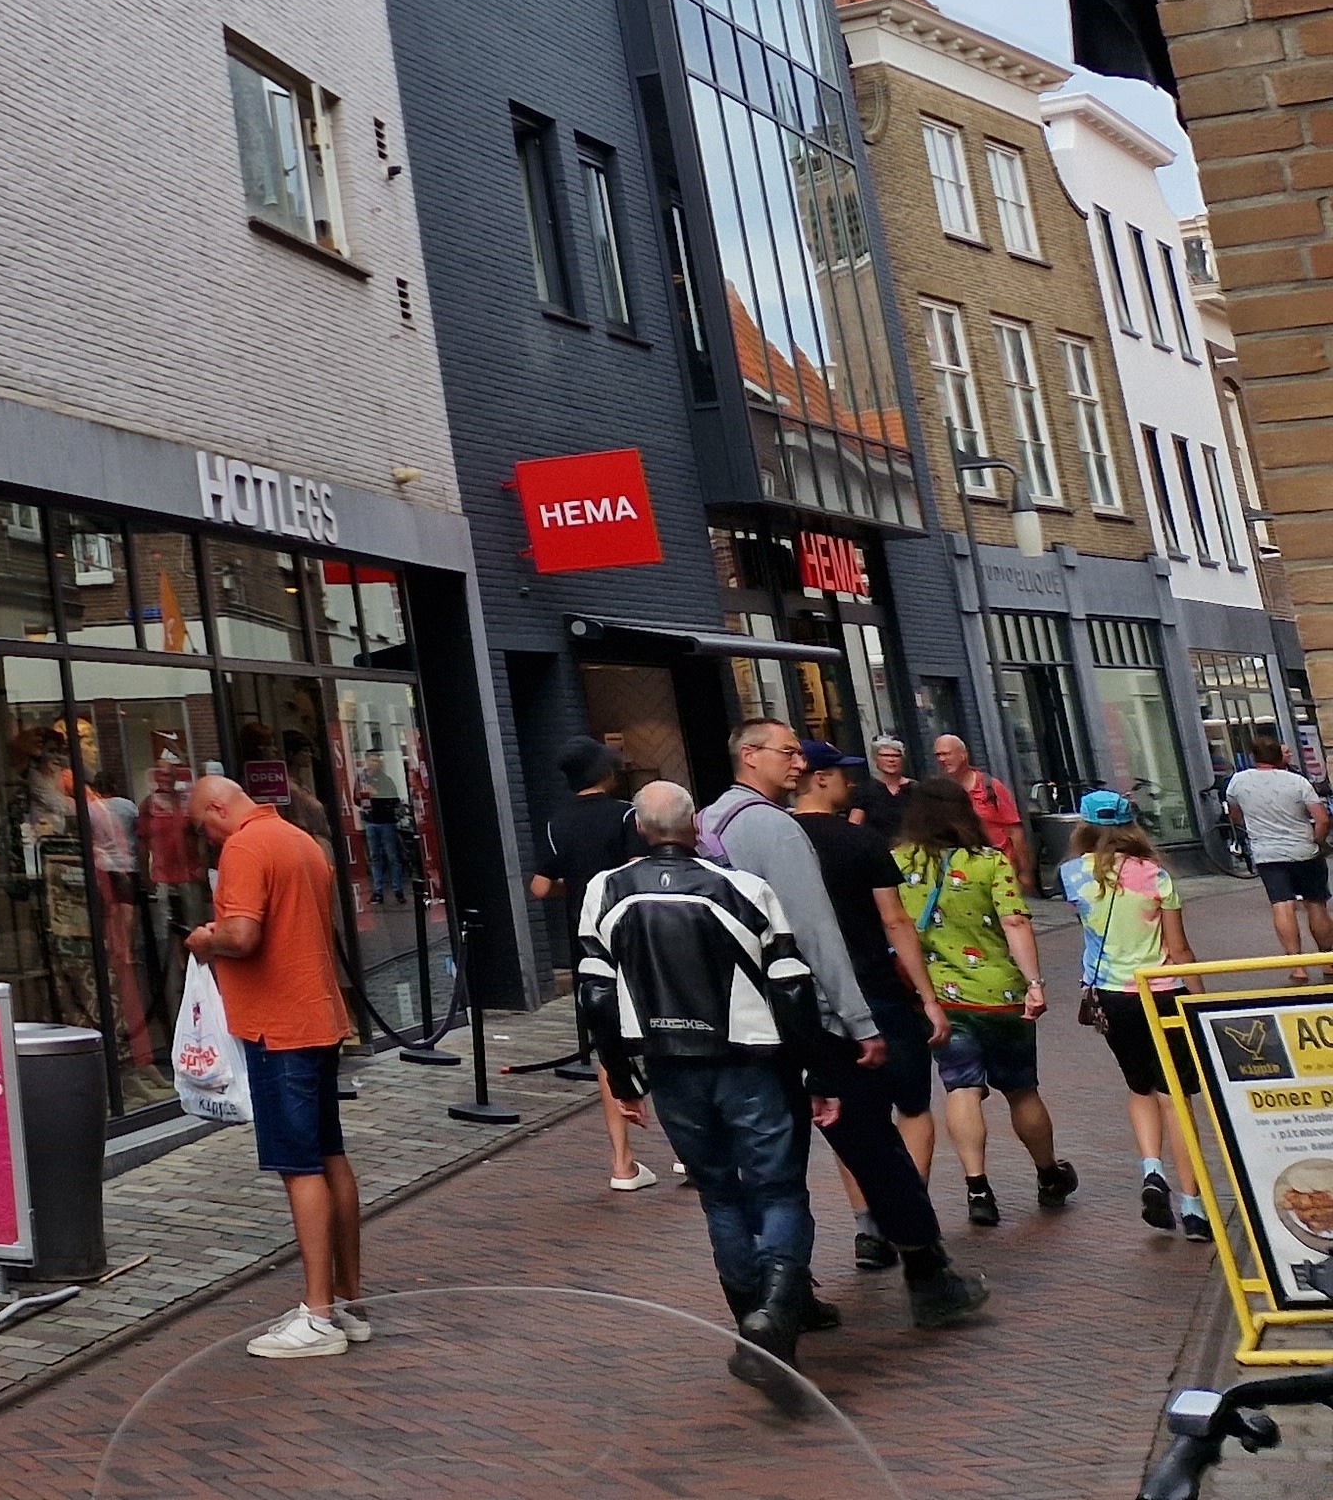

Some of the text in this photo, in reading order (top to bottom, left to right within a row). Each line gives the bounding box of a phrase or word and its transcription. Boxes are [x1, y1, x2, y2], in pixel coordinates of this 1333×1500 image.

[195, 450, 339, 545] HOTLEGS
[539, 495, 638, 528] HEMA
[800, 530, 869, 596] HEMA
[250, 772, 284, 783] OPEN
[1251, 1090, 1313, 1108] Döner
